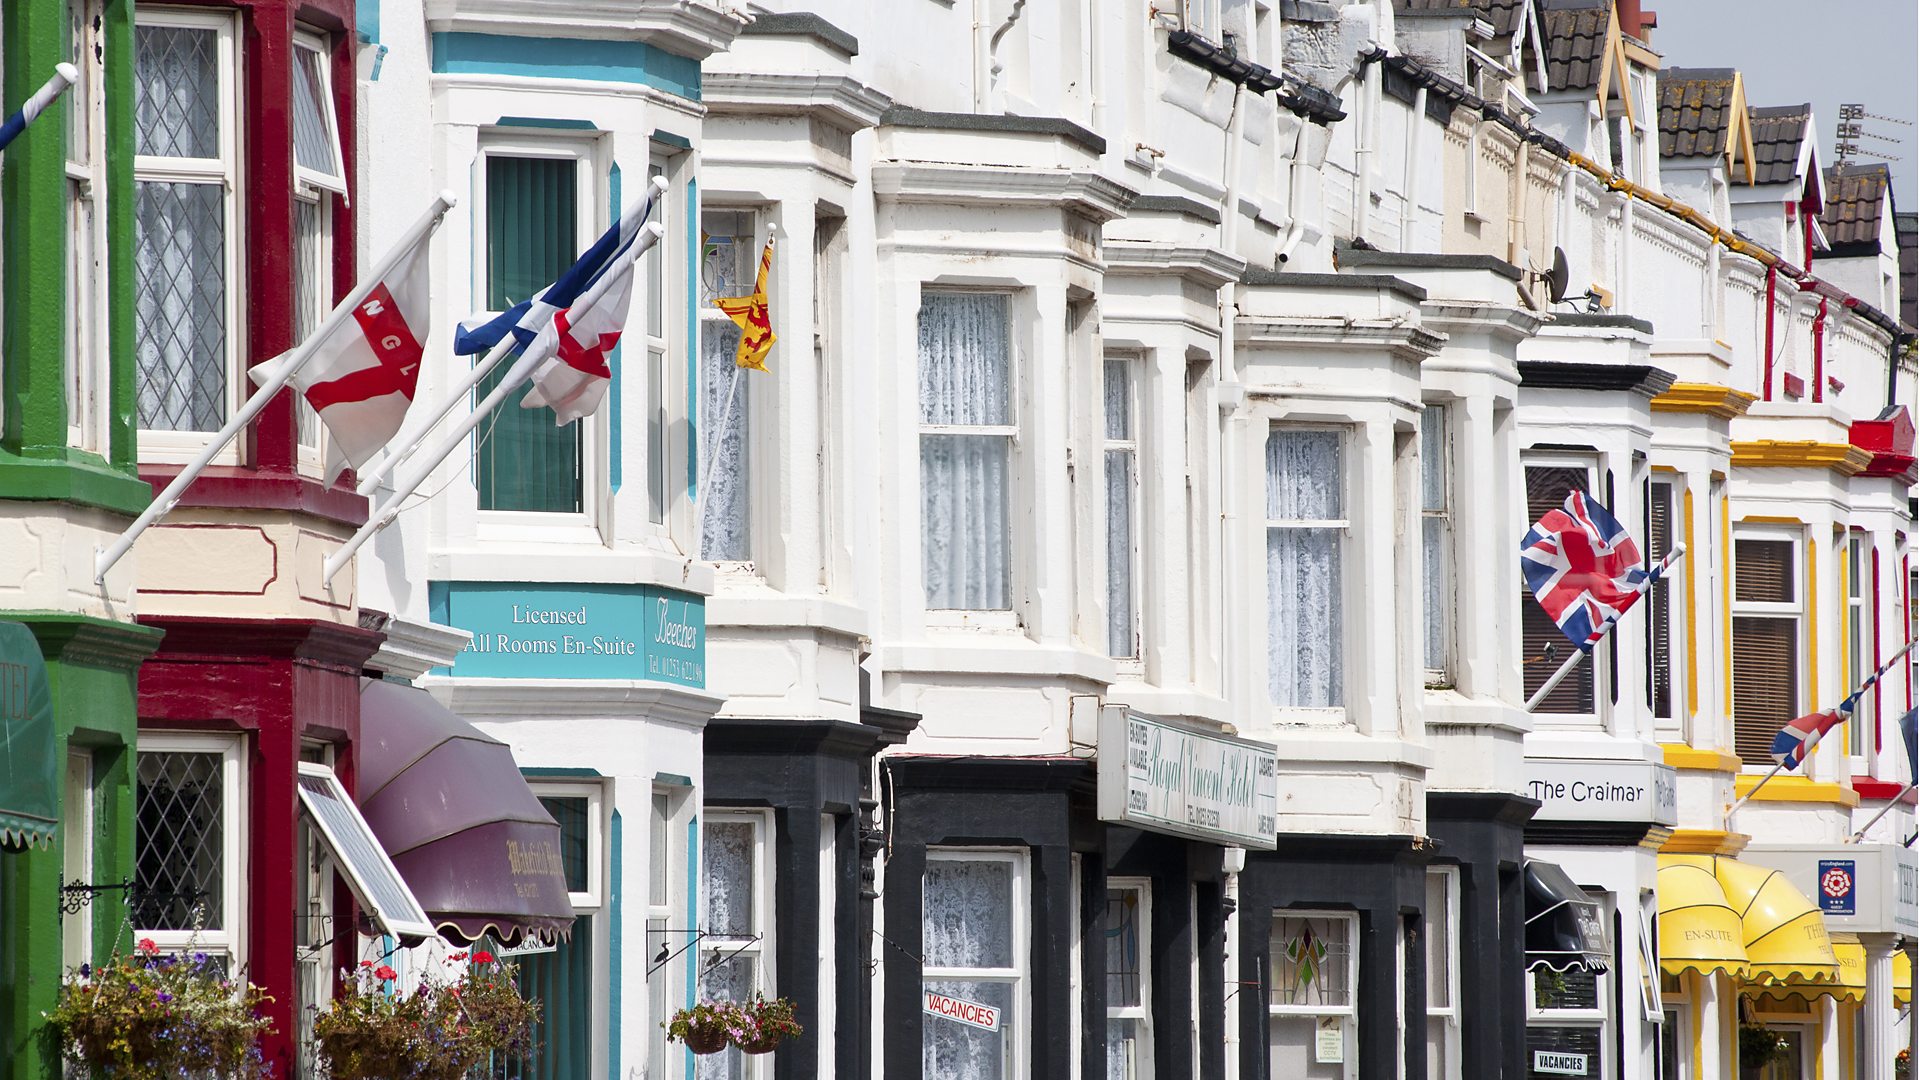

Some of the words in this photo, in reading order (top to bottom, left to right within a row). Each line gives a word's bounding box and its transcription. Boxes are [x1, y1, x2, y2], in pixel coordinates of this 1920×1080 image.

[512, 604, 587, 625] Licensed
[655, 597, 697, 649] Beeches
[463, 633, 490, 653] All
[496, 634, 557, 653] Rooms
[562, 635, 635, 655] En-Suite
[1148, 726, 1186, 818] Royal
[1186, 737, 1225, 802] Vincent
[1227, 748, 1257, 808] Hotel
[1529, 780, 1566, 801] The
[1571, 781, 1645, 802] Craimar
[1684, 930, 1733, 942] EN-SUITE
[928, 993, 994, 1027] VACANCIES
[1539, 1055, 1583, 1070] VACANCIES
